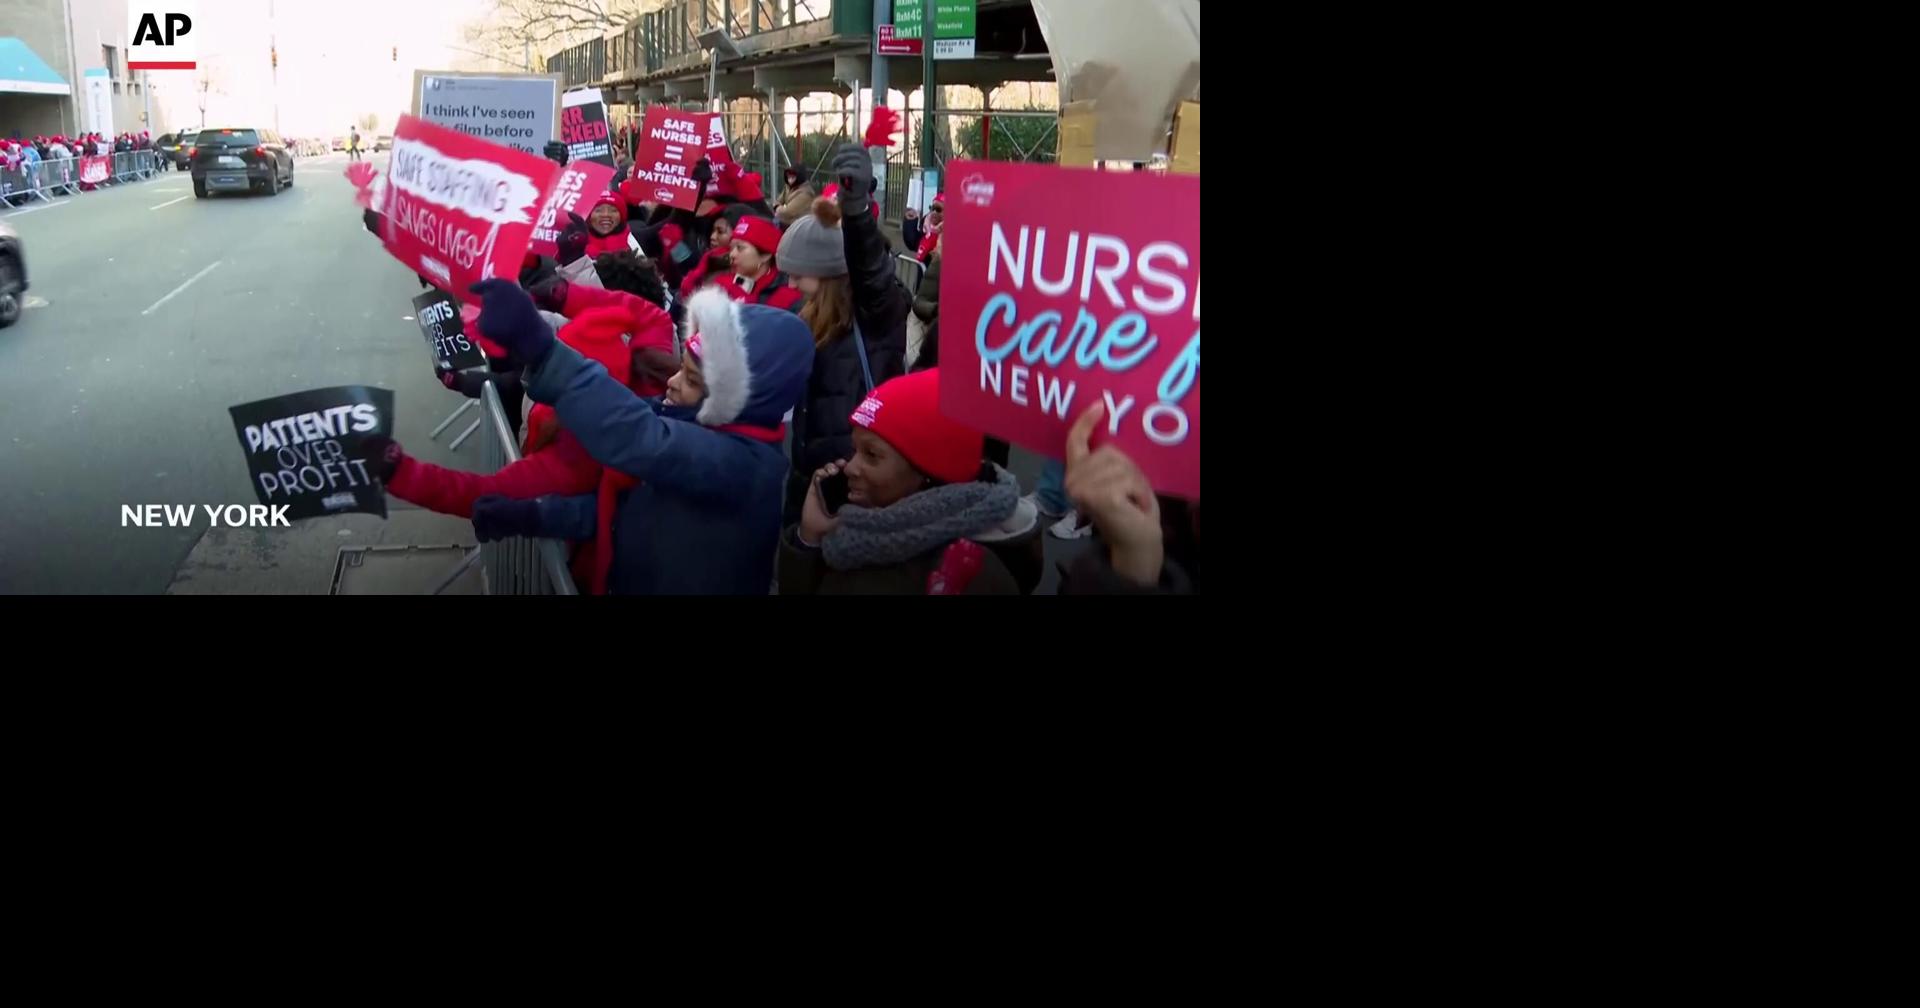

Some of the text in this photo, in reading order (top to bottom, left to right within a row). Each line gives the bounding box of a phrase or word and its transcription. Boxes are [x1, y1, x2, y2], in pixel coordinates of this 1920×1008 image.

[426, 103, 535, 119] I think I've seen
[484, 125, 534, 138] before
[651, 128, 702, 146] NURSES
[663, 118, 695, 133] SAFE
[396, 149, 512, 213] SAFE STAFFING
[637, 169, 697, 189] PATIENTS
[654, 162, 686, 176] SAFE
[394, 195, 437, 248] SAVES
[979, 354, 1077, 421] NEW
[244, 402, 379, 455] PATIENTS
[276, 439, 348, 470] OVER
[259, 459, 367, 501] PROFIT
